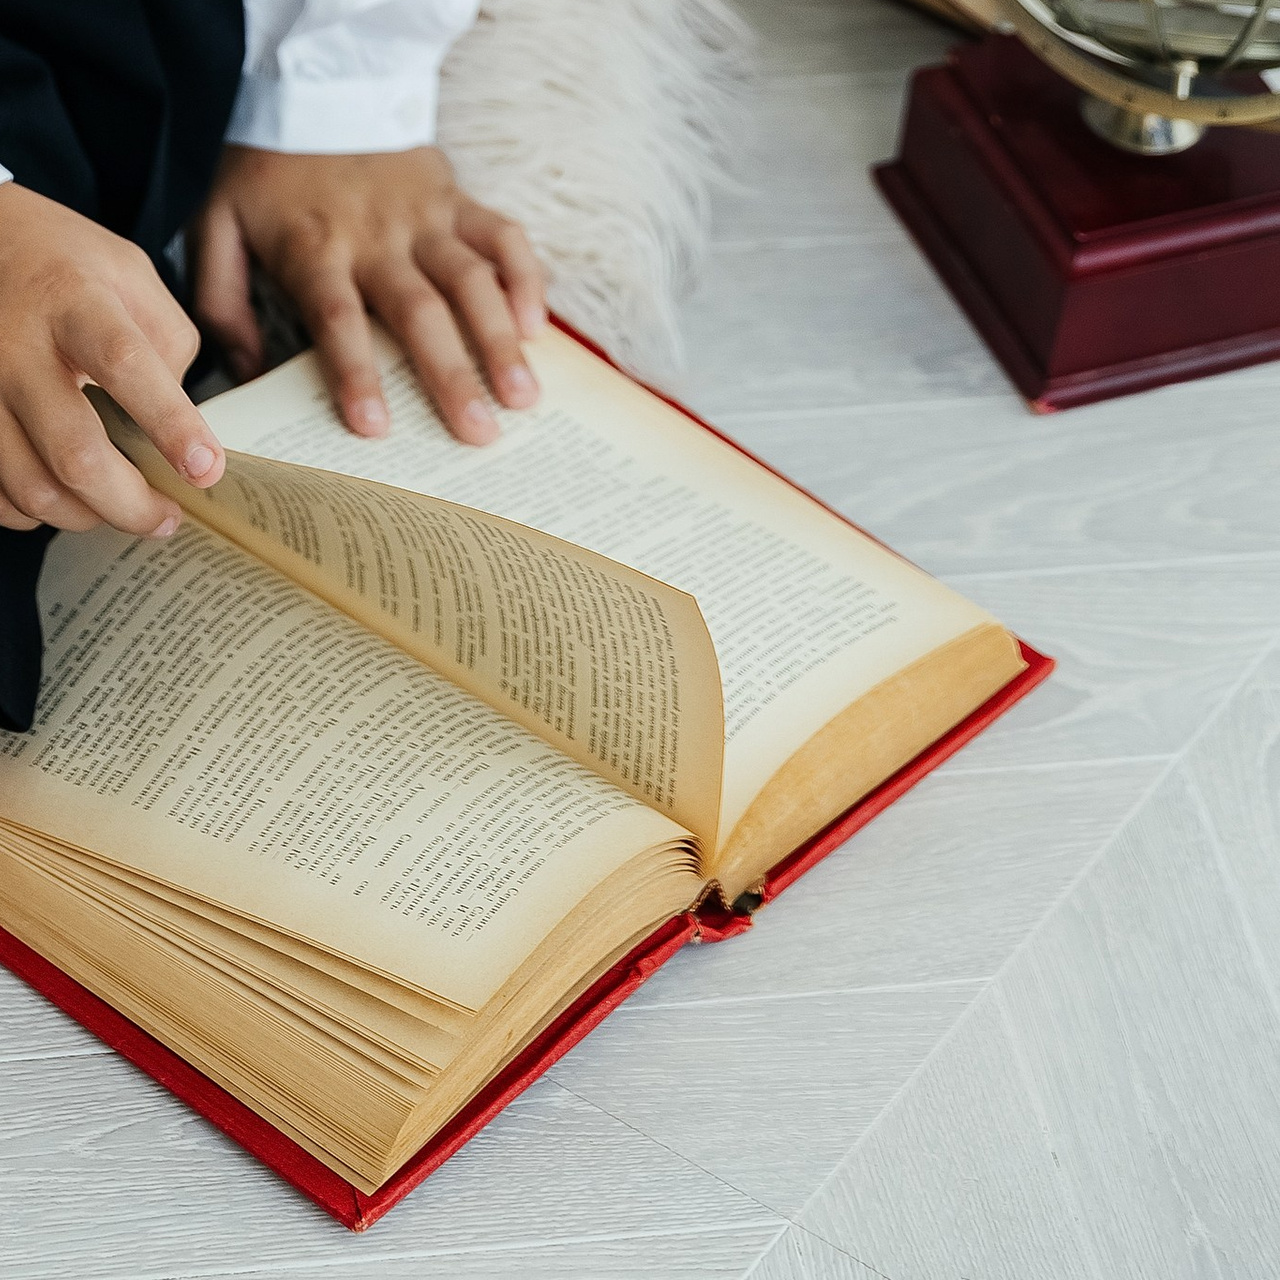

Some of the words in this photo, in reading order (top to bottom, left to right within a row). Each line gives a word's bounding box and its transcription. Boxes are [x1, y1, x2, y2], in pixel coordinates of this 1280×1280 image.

[303, 771, 333, 800] где-то
[339, 762, 376, 796] Просит
[362, 748, 408, 790] остальном
[140, 774, 177, 812] Синцов
[174, 775, 220, 824] краткости
[202, 789, 224, 809] ему
[312, 773, 347, 808] сумели
[359, 790, 383, 811] Под
[374, 797, 394, 814] без
[452, 777, 507, 820] командарме
[185, 810, 206, 829] про
[198, 809, 225, 835] штаб
[220, 797, 266, 844] Козыреве
[257, 798, 294, 838] мозгами
[280, 802, 306, 828] здесь
[311, 795, 344, 827] узнать
[359, 813, 378, 829] нас
[413, 790, 453, 825] спросил
[467, 811, 486, 826] что
[477, 797, 521, 833] знакомые
[516, 802, 535, 815] что
[279, 810, 316, 848] вывезти
[294, 827, 316, 846] про
[304, 801, 357, 855] нормально!
[331, 809, 366, 842] чужой
[451, 824, 471, 842] они
[483, 813, 523, 844] Синцов
[515, 819, 551, 848] дорогу,
[256, 830, 283, 857] похо-
[280, 847, 301, 866] Ко-
[304, 842, 336, 875] коман-
[313, 828, 365, 881] обойдутся.
[343, 833, 378, 866] Будем
[373, 831, 414, 871] Синцов,
[400, 833, 446, 879] больно-то
[450, 833, 480, 860] люди,
[513, 843, 541, 866] хуже
[350, 878, 370, 896] сев
[425, 848, 484, 906] Артемьевым
[450, 860, 491, 898] Синцов,
[481, 867, 519, 903] видать!
[515, 856, 547, 885] сказал
[375, 879, 402, 906] пого-
[386, 876, 424, 912] «Пусть
[400, 871, 444, 916] вспомнил
[422, 904, 449, 927] сядь
[447, 904, 486, 939] Садись
